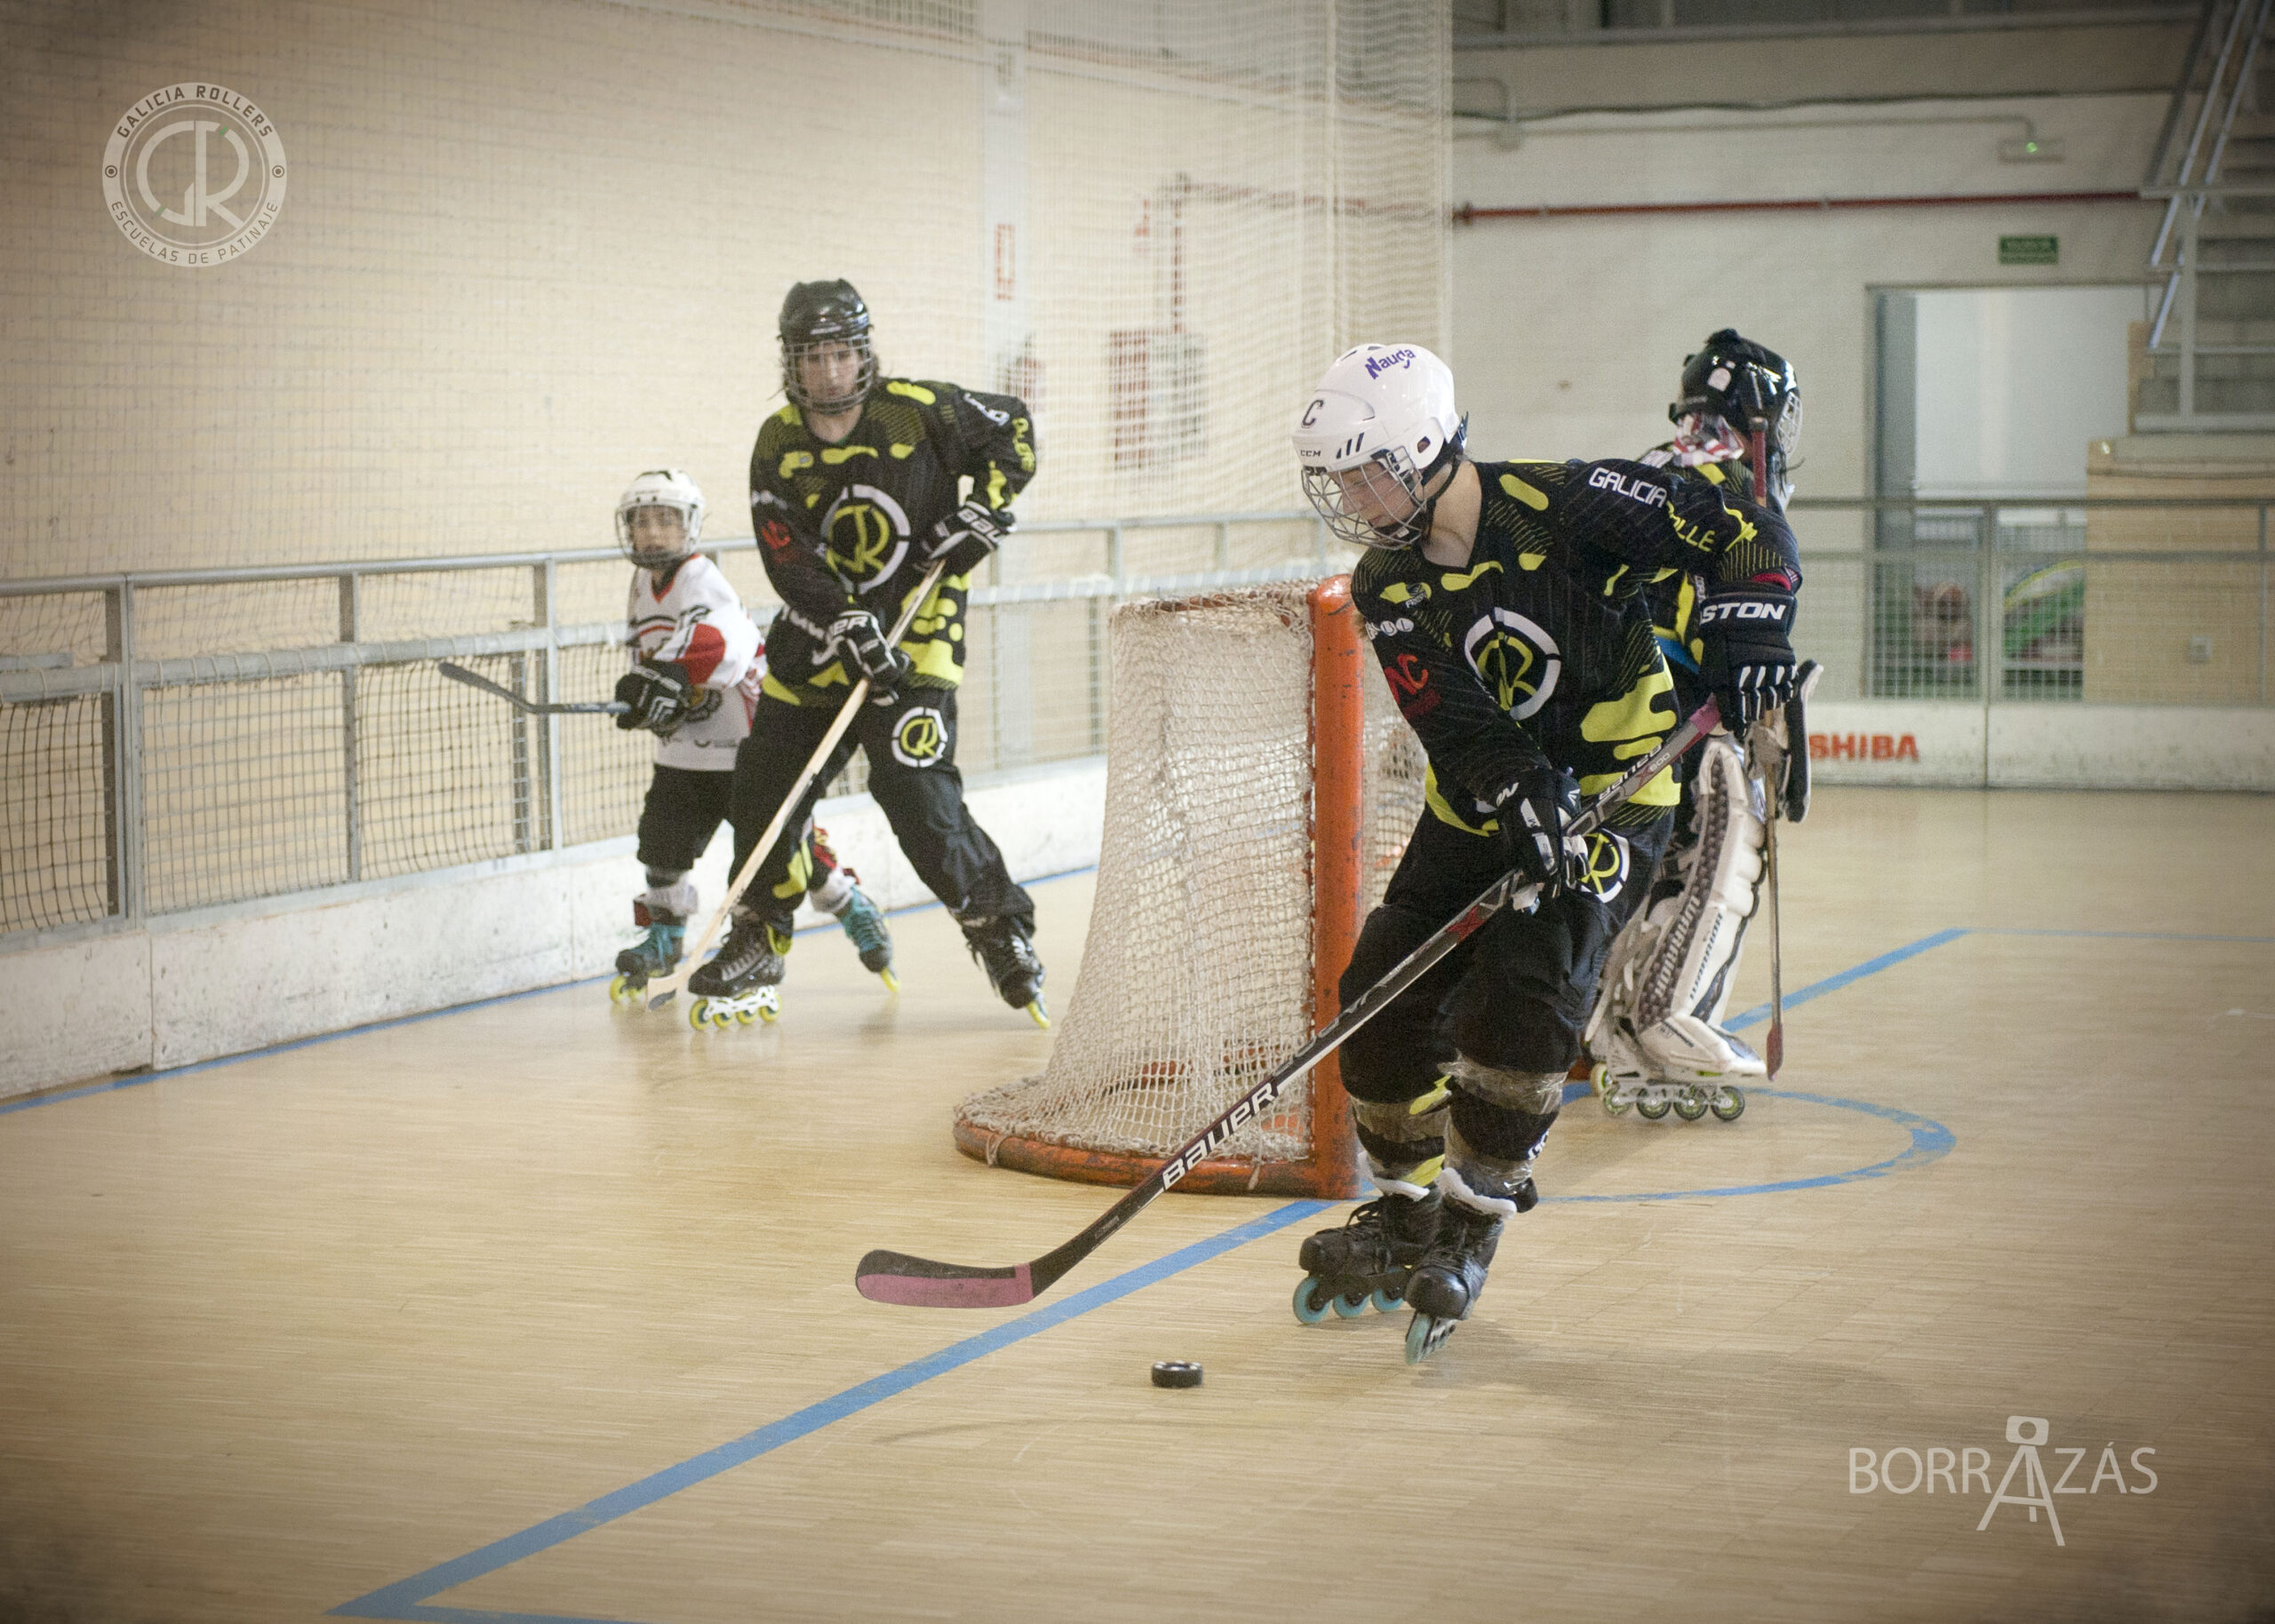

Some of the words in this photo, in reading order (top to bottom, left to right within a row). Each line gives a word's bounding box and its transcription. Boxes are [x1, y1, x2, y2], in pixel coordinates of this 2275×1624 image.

[1301, 399, 1324, 428] C
[1588, 466, 1668, 508] GALICIA
[1699, 601, 1787, 625] STON
